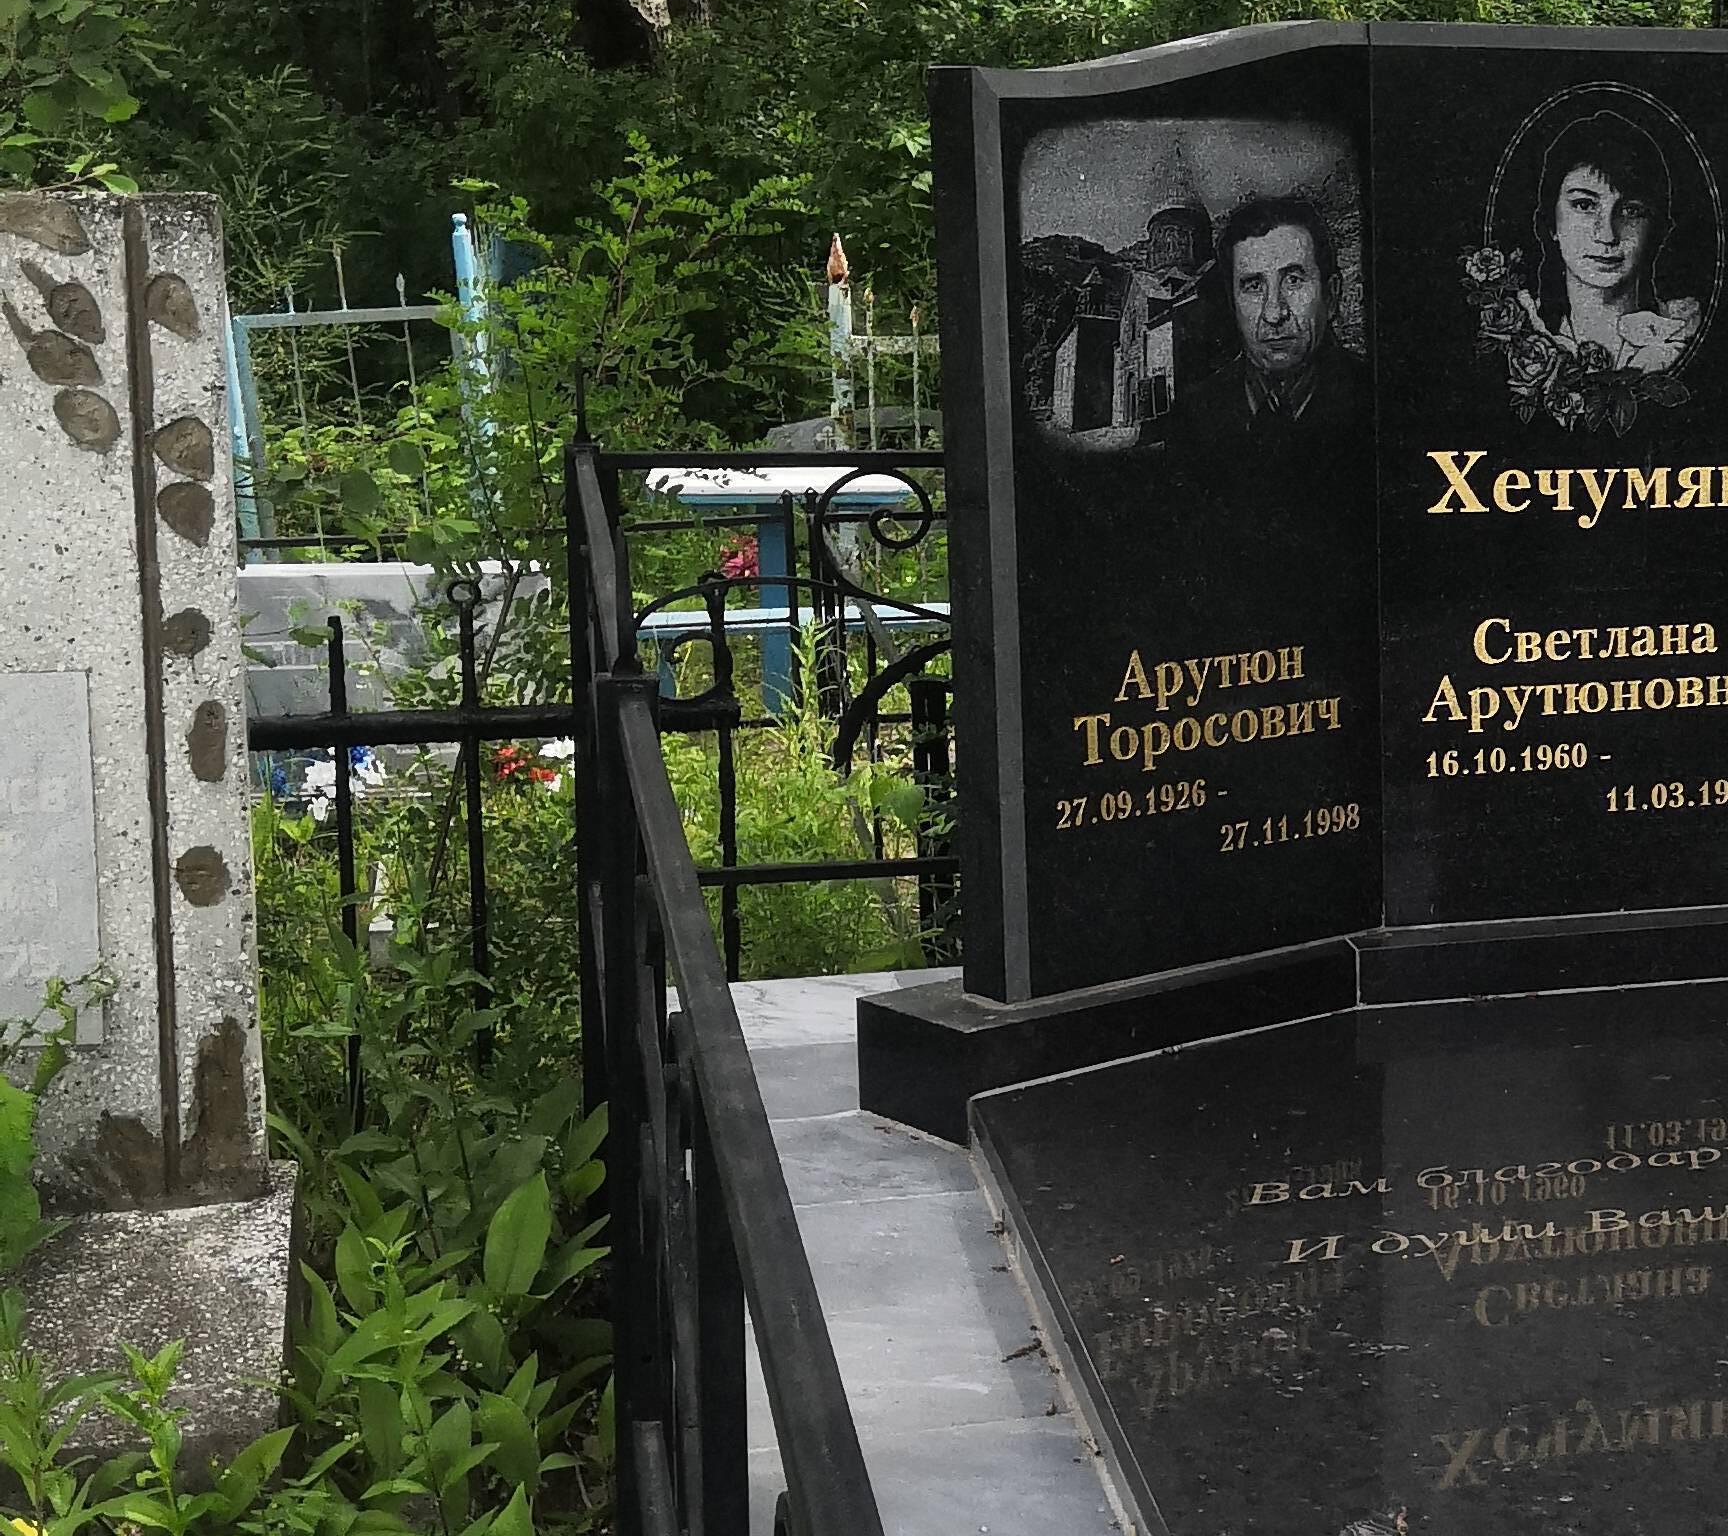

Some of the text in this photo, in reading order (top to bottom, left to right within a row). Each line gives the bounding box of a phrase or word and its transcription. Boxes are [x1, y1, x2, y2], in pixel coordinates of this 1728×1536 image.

[1474, 618, 1718, 664] Светлана
[1115, 647, 1305, 712] Арутюн
[1074, 695, 1341, 771] Торосович
[1426, 742, 1588, 778] 16.10.1960
[1056, 779, 1206, 830] 27.09.1926
[1220, 803, 1360, 852] 27.11.1998
[1248, 1176, 1392, 1205] Вам
[1283, 1233, 1345, 1264] И
[1371, 1216, 1563, 1260] души
